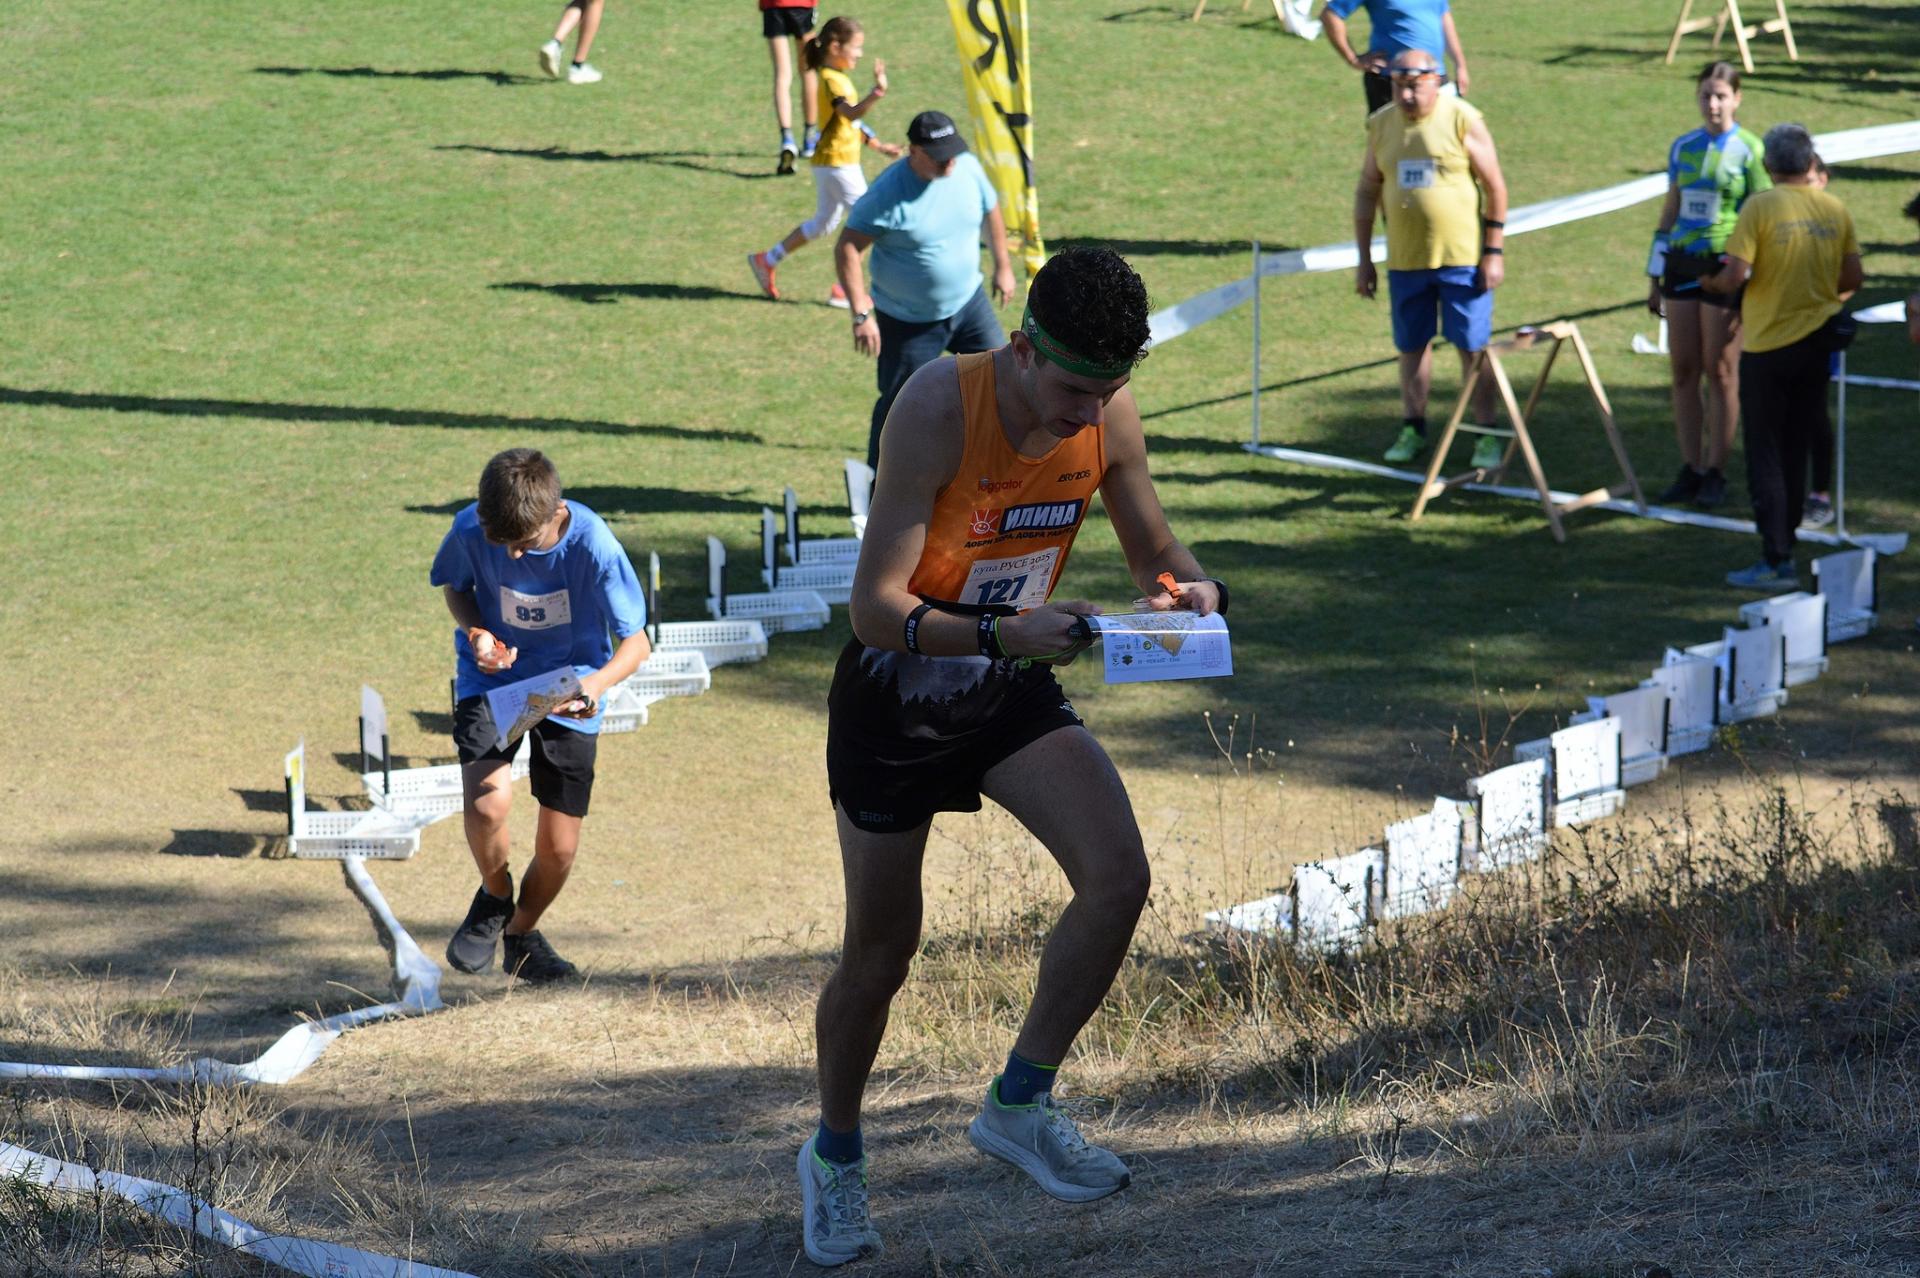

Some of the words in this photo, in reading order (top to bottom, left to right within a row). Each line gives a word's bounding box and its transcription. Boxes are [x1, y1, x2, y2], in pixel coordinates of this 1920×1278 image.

[1004, 503, 1077, 531] ИЛИНА
[999, 558, 1029, 572] РУСЕ
[978, 574, 1029, 605] 127
[515, 605, 546, 622] 93
